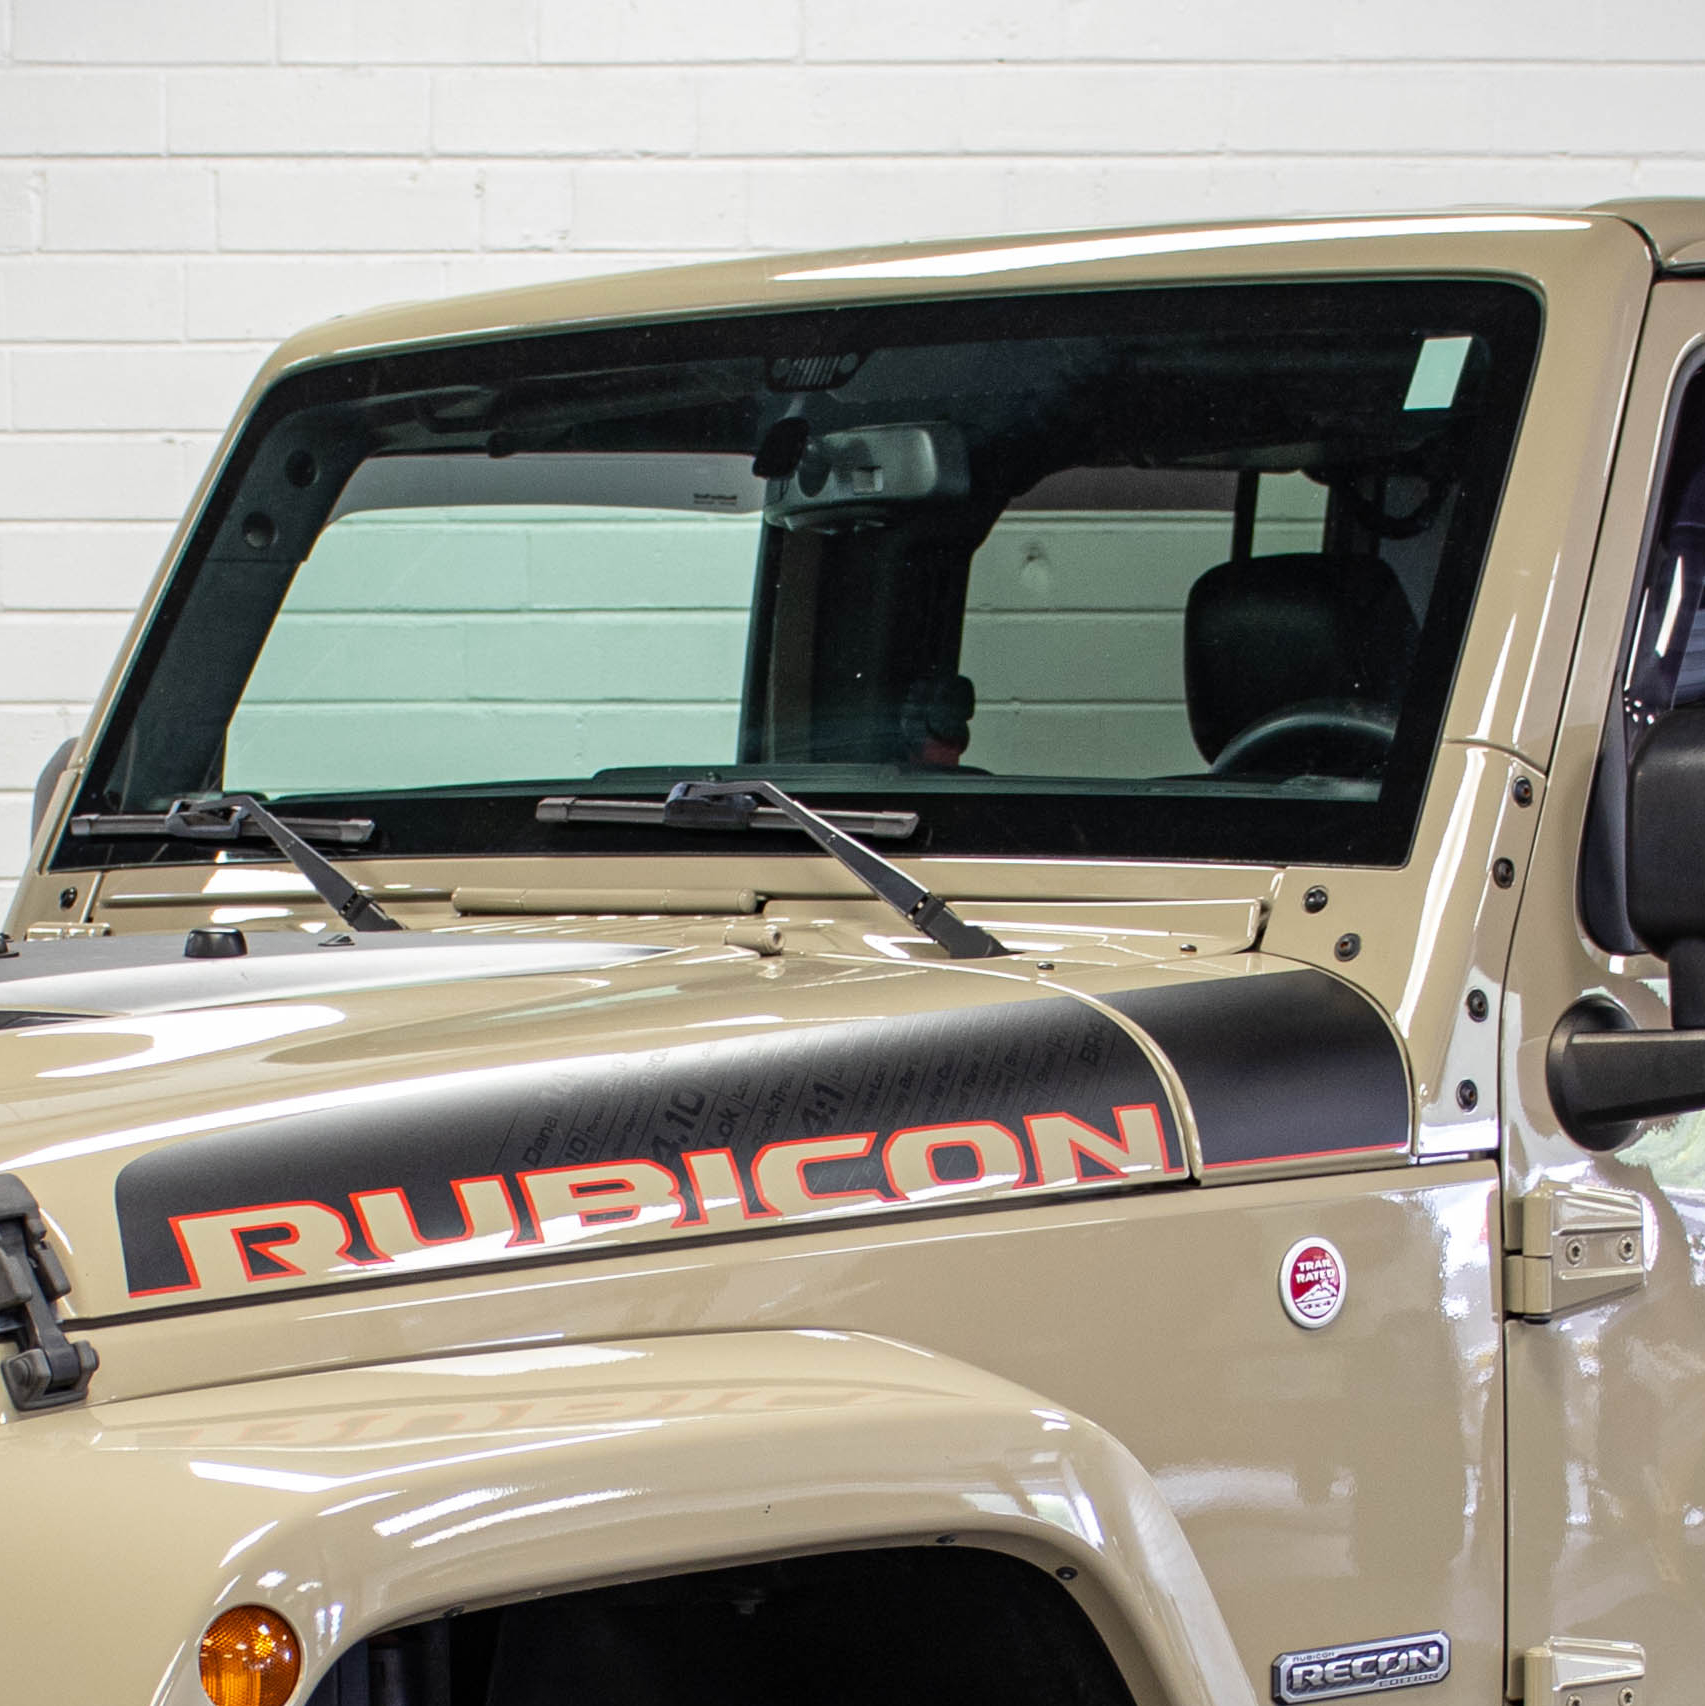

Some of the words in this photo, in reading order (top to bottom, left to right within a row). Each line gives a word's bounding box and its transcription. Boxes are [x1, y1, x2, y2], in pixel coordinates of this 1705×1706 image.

[168, 1103, 1184, 1290] RUBICON
[1297, 1259, 1332, 1272] TRAIL
[1296, 1268, 1335, 1284] RATED
[1293, 1651, 1335, 1662] RUBICON
[1293, 1646, 1439, 1690] RECON
[1378, 1673, 1440, 1688] EDITION
